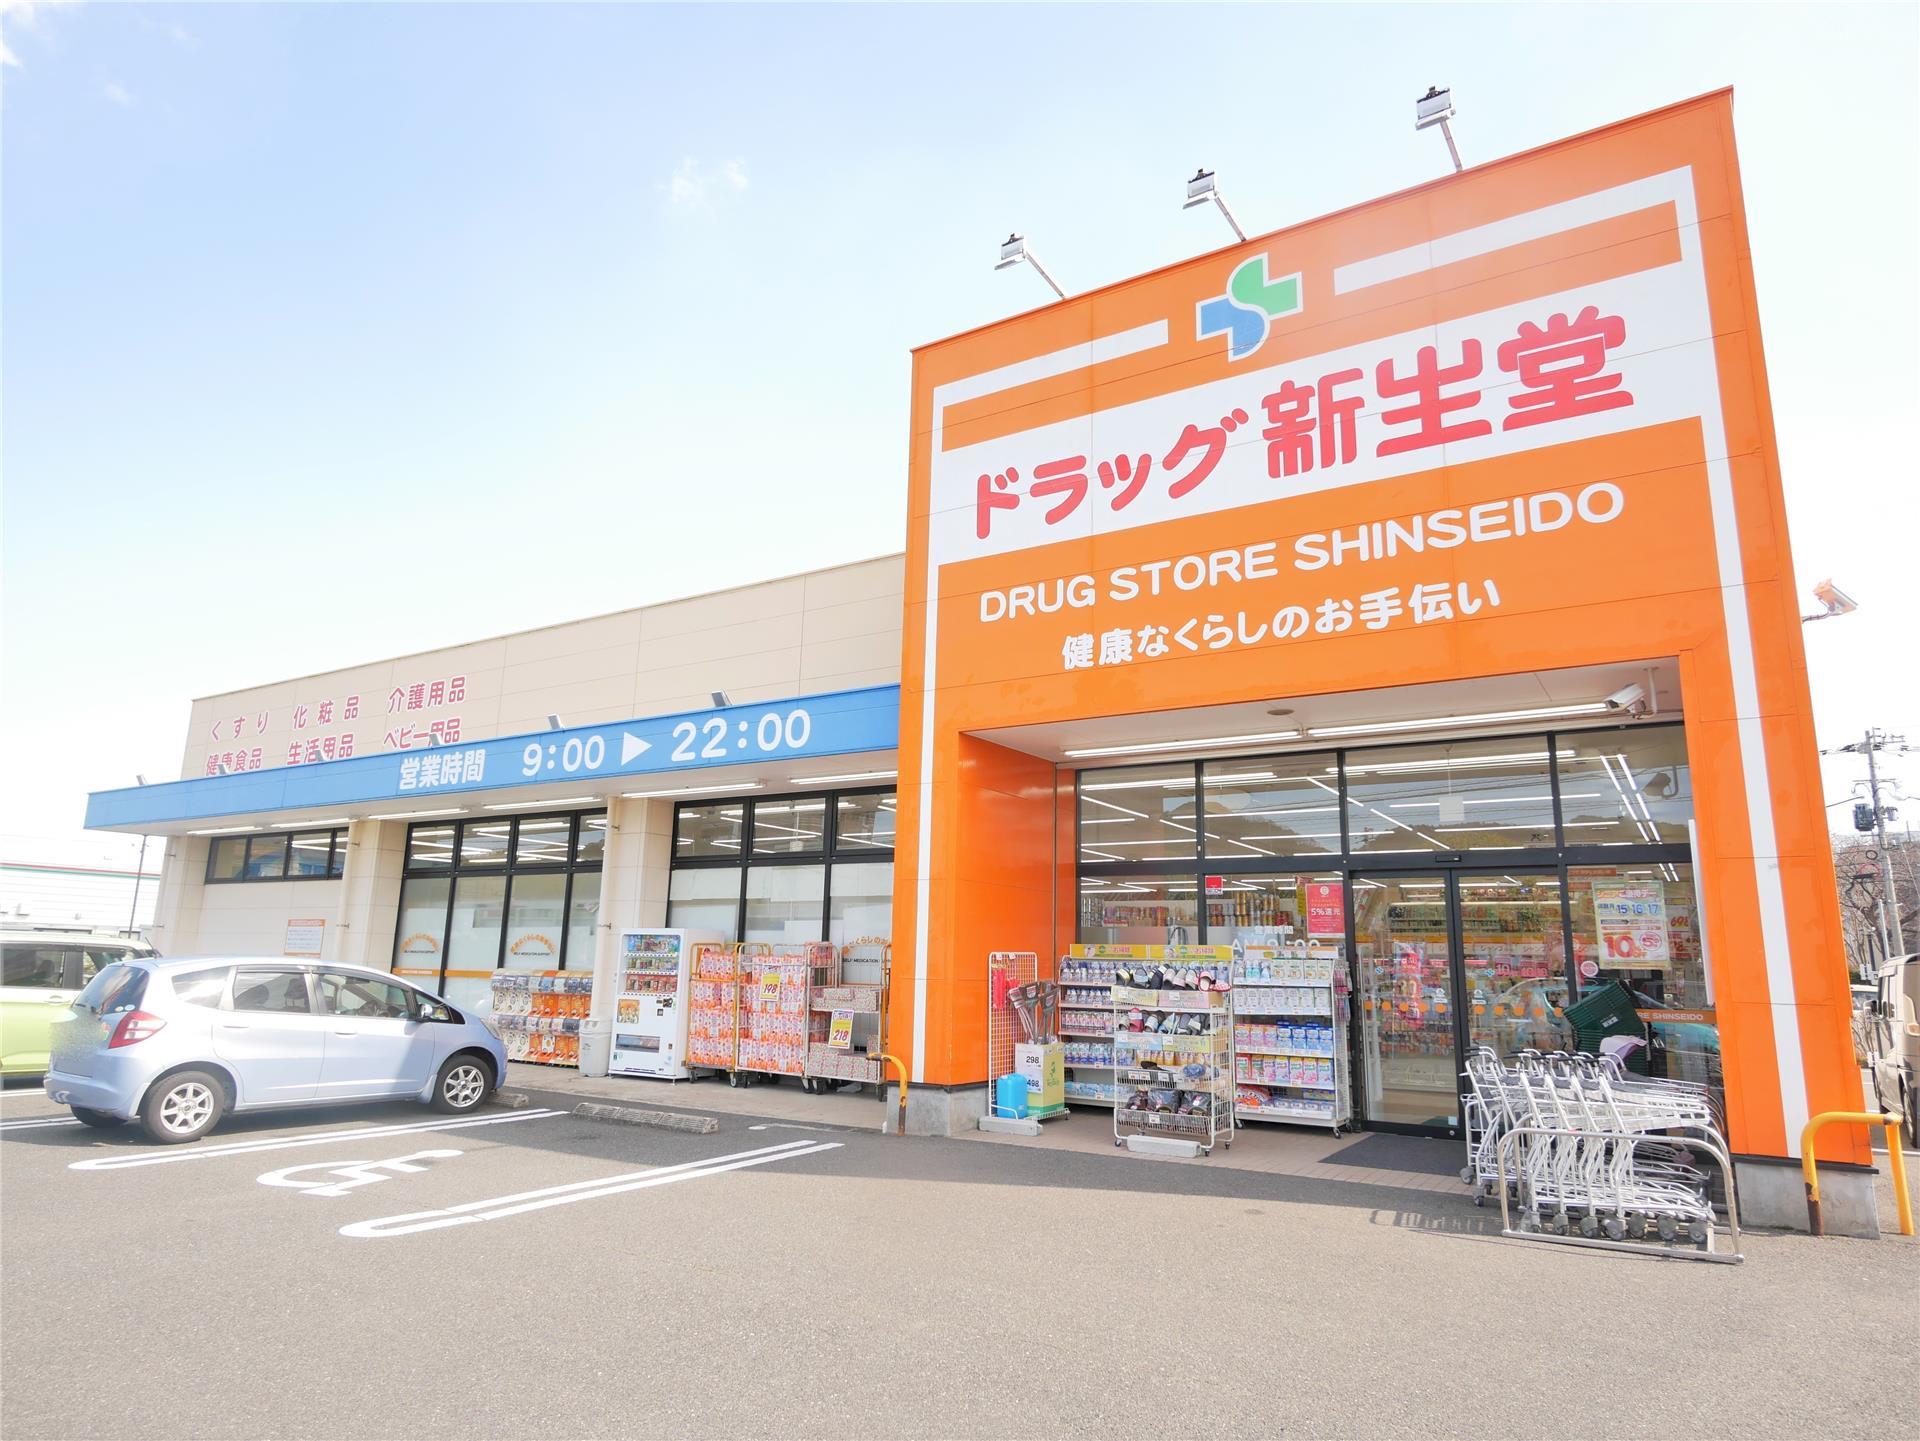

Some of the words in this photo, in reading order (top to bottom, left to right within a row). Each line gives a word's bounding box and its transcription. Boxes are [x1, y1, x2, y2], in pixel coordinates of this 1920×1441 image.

[976, 305, 1635, 540] ドラッグ新生堂
[979, 574, 1096, 623] DRUG
[1108, 541, 1279, 602] STORE
[1294, 481, 1625, 571] SHINSEIDO
[1061, 578, 1501, 670] 健康なくらしのお手伝い
[209, 711, 269, 742] くすり
[293, 695, 360, 730] 化粧品
[388, 675, 467, 714] 介護用品
[286, 733, 355, 767] 生活用品
[399, 748, 487, 791] 営業時間
[521, 734, 606, 778] 9:00
[671, 708, 812, 763] 22:00
[763, 984, 778, 994] 198
[833, 1029, 849, 1041] 218
[1026, 1056, 1040, 1064] 298
